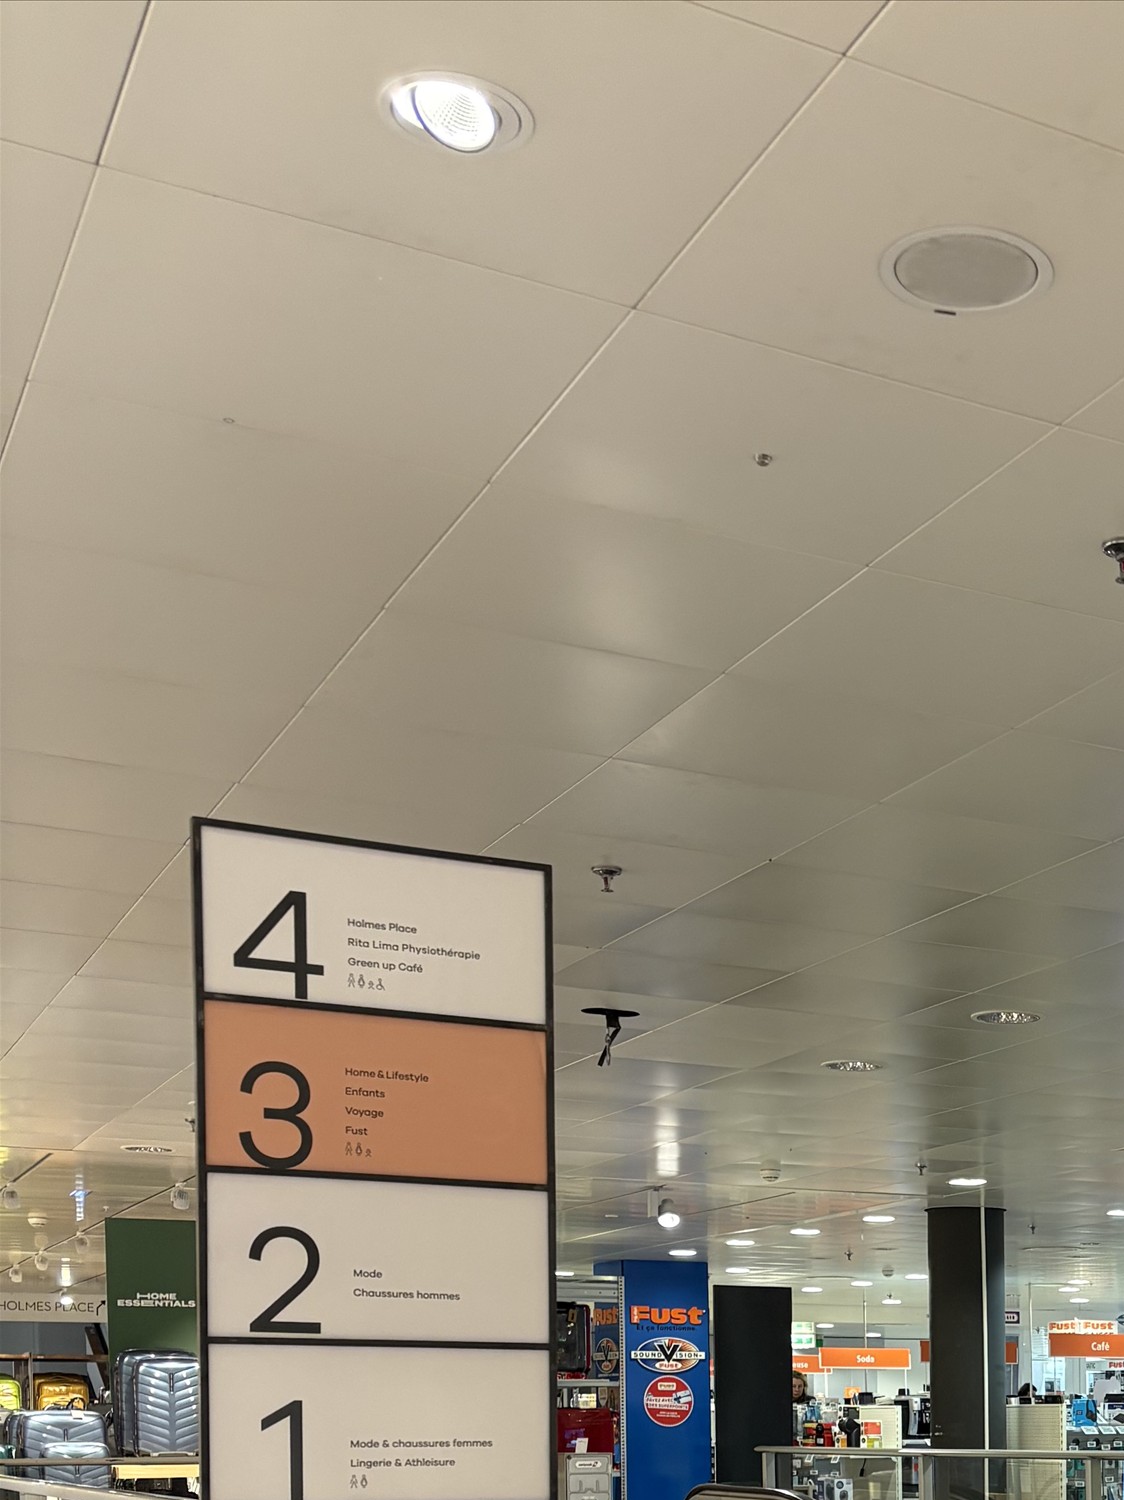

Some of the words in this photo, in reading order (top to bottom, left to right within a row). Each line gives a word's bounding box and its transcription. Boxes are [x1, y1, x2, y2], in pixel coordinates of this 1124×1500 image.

[347, 918, 387, 932] Holmes
[389, 920, 417, 934] Place
[234, 890, 324, 999] 4
[348, 938, 370, 949] Rita
[372, 940, 399, 951] Lima
[402, 942, 481, 961] Physiothérapie
[348, 957, 380, 970] Green
[382, 962, 396, 972] up
[398, 961, 423, 973] Café
[345, 1067, 375, 1079] Home
[377, 1070, 385, 1079] &
[386, 1070, 429, 1084] Lifestyle
[345, 1086, 385, 1098] Enfants
[239, 1061, 313, 1169] 3
[345, 1106, 384, 1119] Voyage
[345, 1126, 368, 1137] Fust
[249, 1226, 321, 1334] 2
[353, 1269, 383, 1279] Mode
[137, 1292, 177, 1300] HOME
[353, 1288, 414, 1299] Chaussures
[416, 1290, 460, 1301] hommes
[55, 1301, 94, 1313] PLACE
[117, 1300, 196, 1308] ESSENTIALS
[630, 1305, 704, 1325] Fust
[1083, 1322, 1114, 1330] Fust
[1091, 1341, 1110, 1351] Café
[856, 1355, 875, 1363] Soda
[350, 1439, 379, 1448] Mode
[382, 1439, 390, 1448] &
[392, 1439, 450, 1448] chaussures
[452, 1438, 493, 1448] femmes
[350, 1458, 392, 1469] Lingerie
[395, 1458, 402, 1467] &
[404, 1457, 456, 1467] Athleisure
